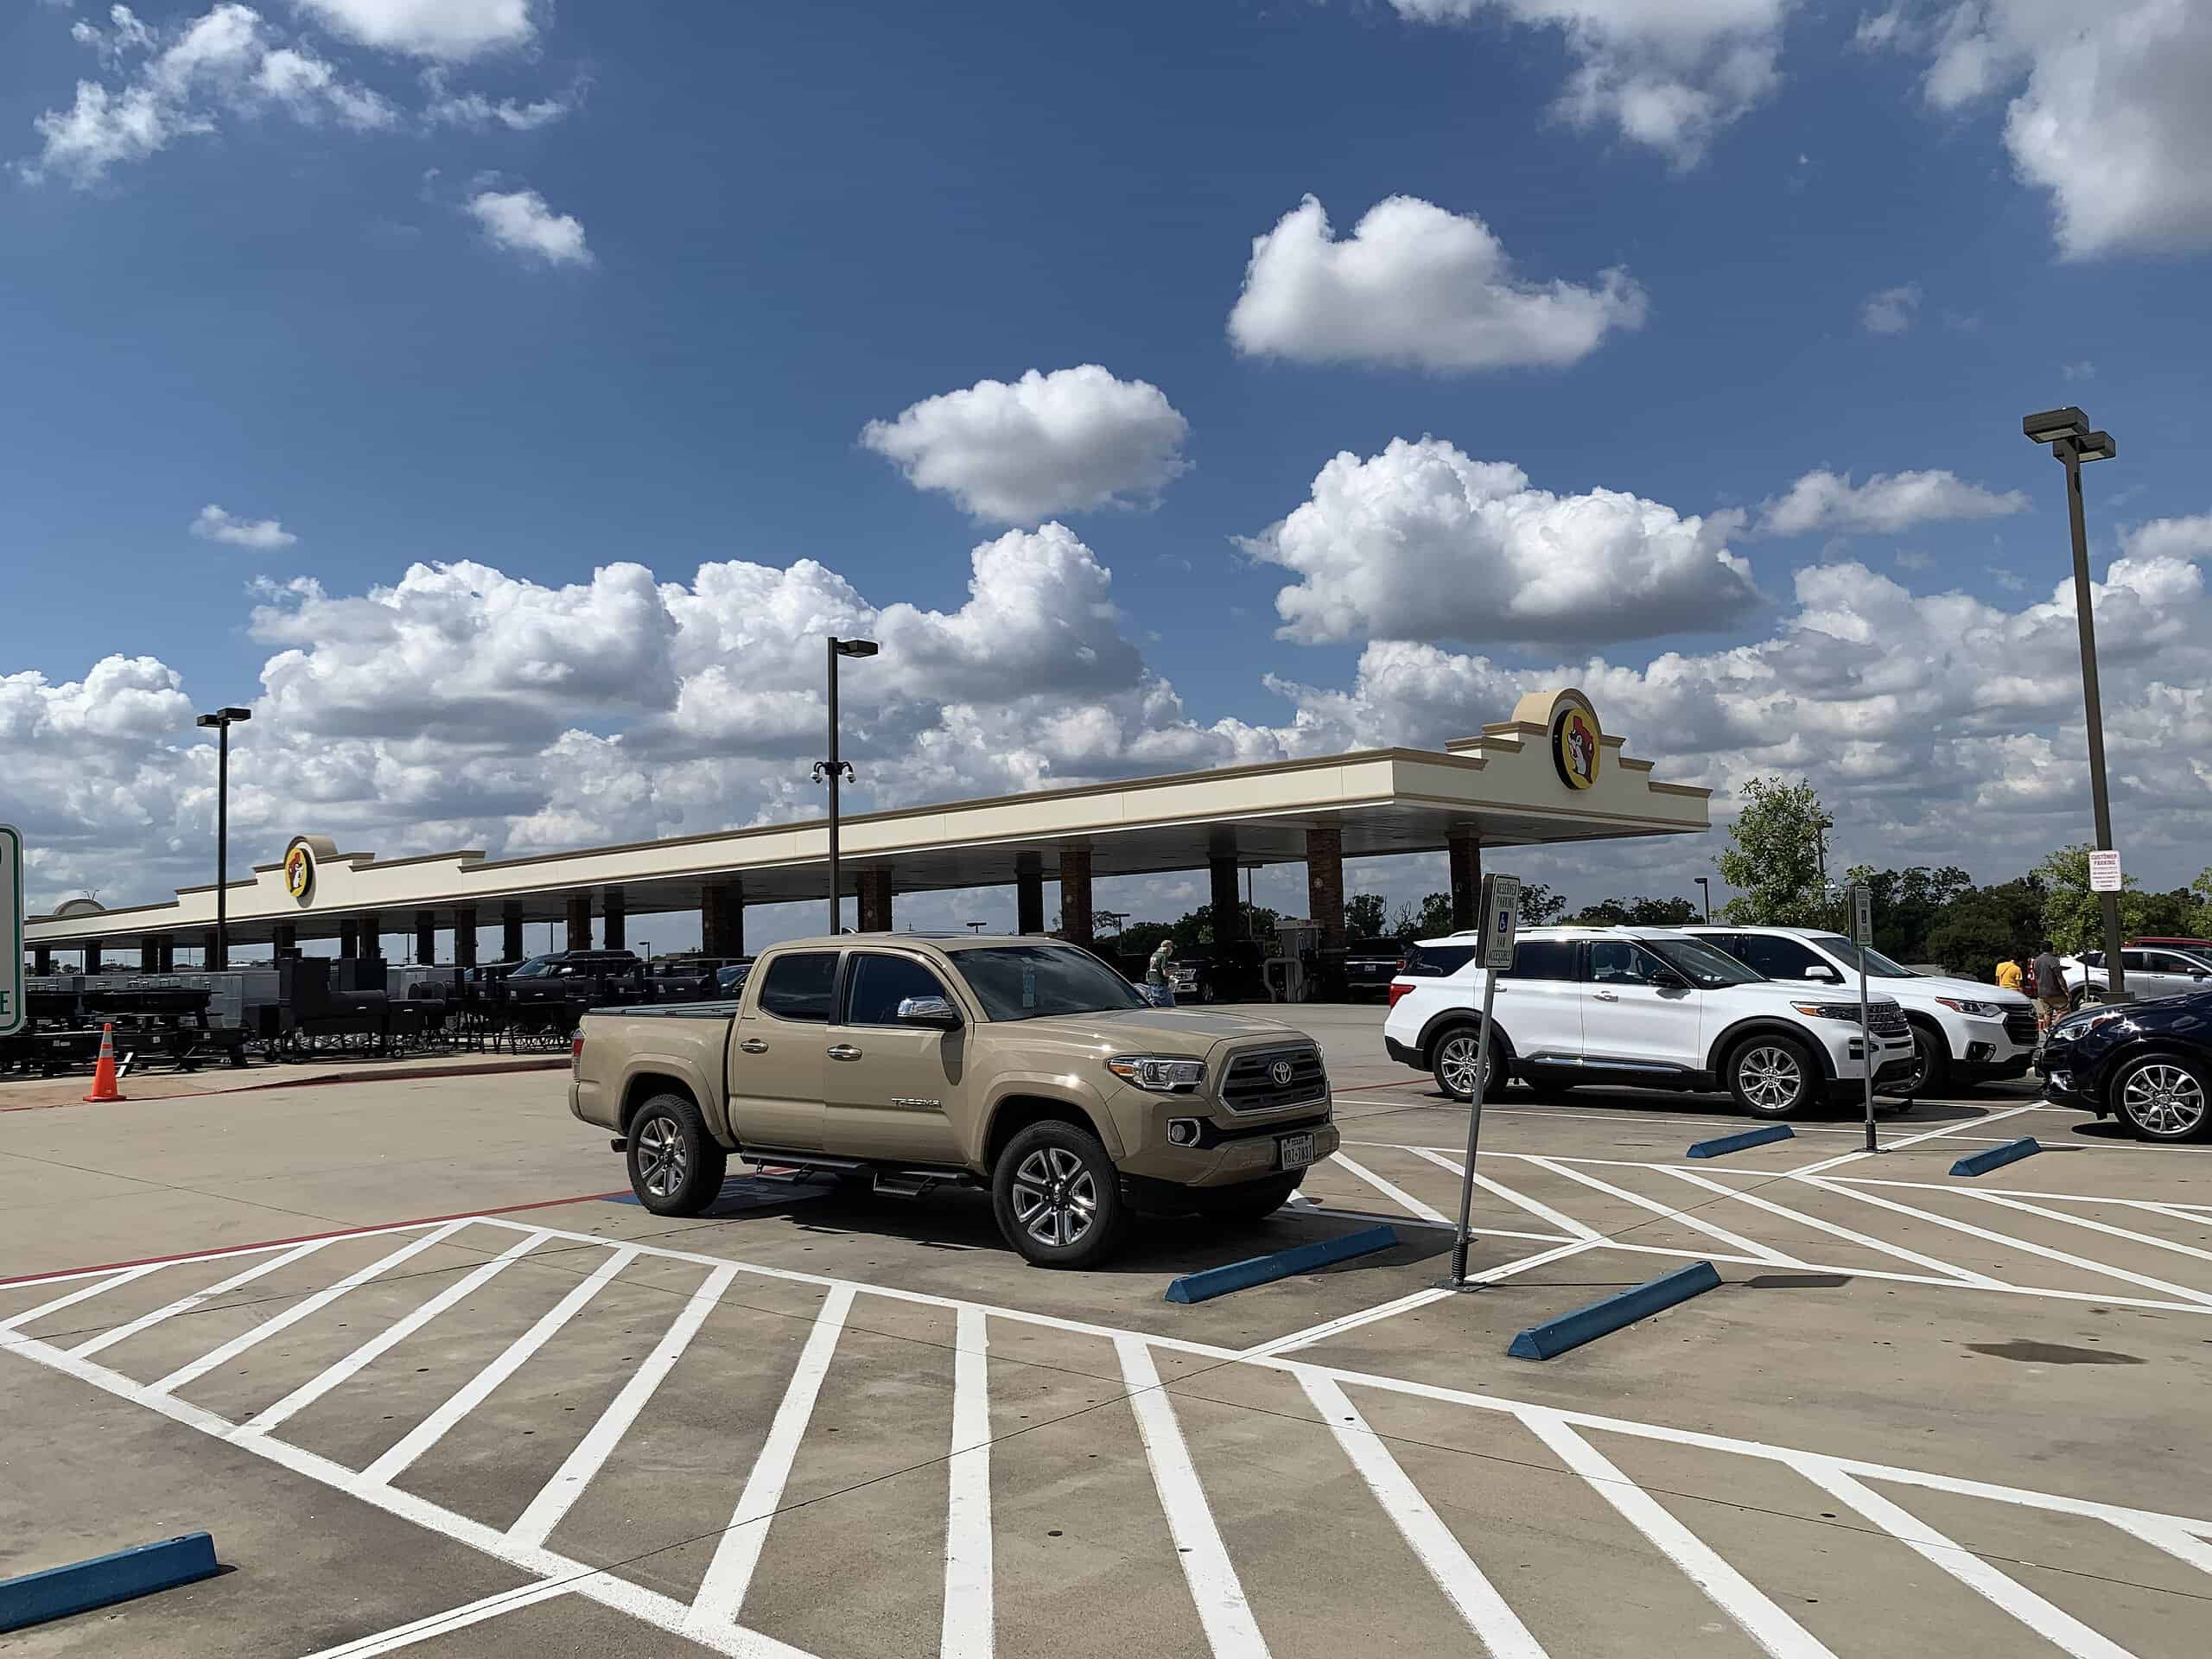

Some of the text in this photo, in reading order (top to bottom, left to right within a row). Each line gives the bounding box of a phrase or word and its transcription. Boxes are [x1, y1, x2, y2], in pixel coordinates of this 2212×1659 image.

[1497, 881, 1517, 895] RESERVED
[1496, 895, 1515, 908] PARKING
[1497, 937, 1505, 948] VAN
[891, 1097, 942, 1108] TACOMA
[1291, 1137, 1304, 1146] TEXAS
